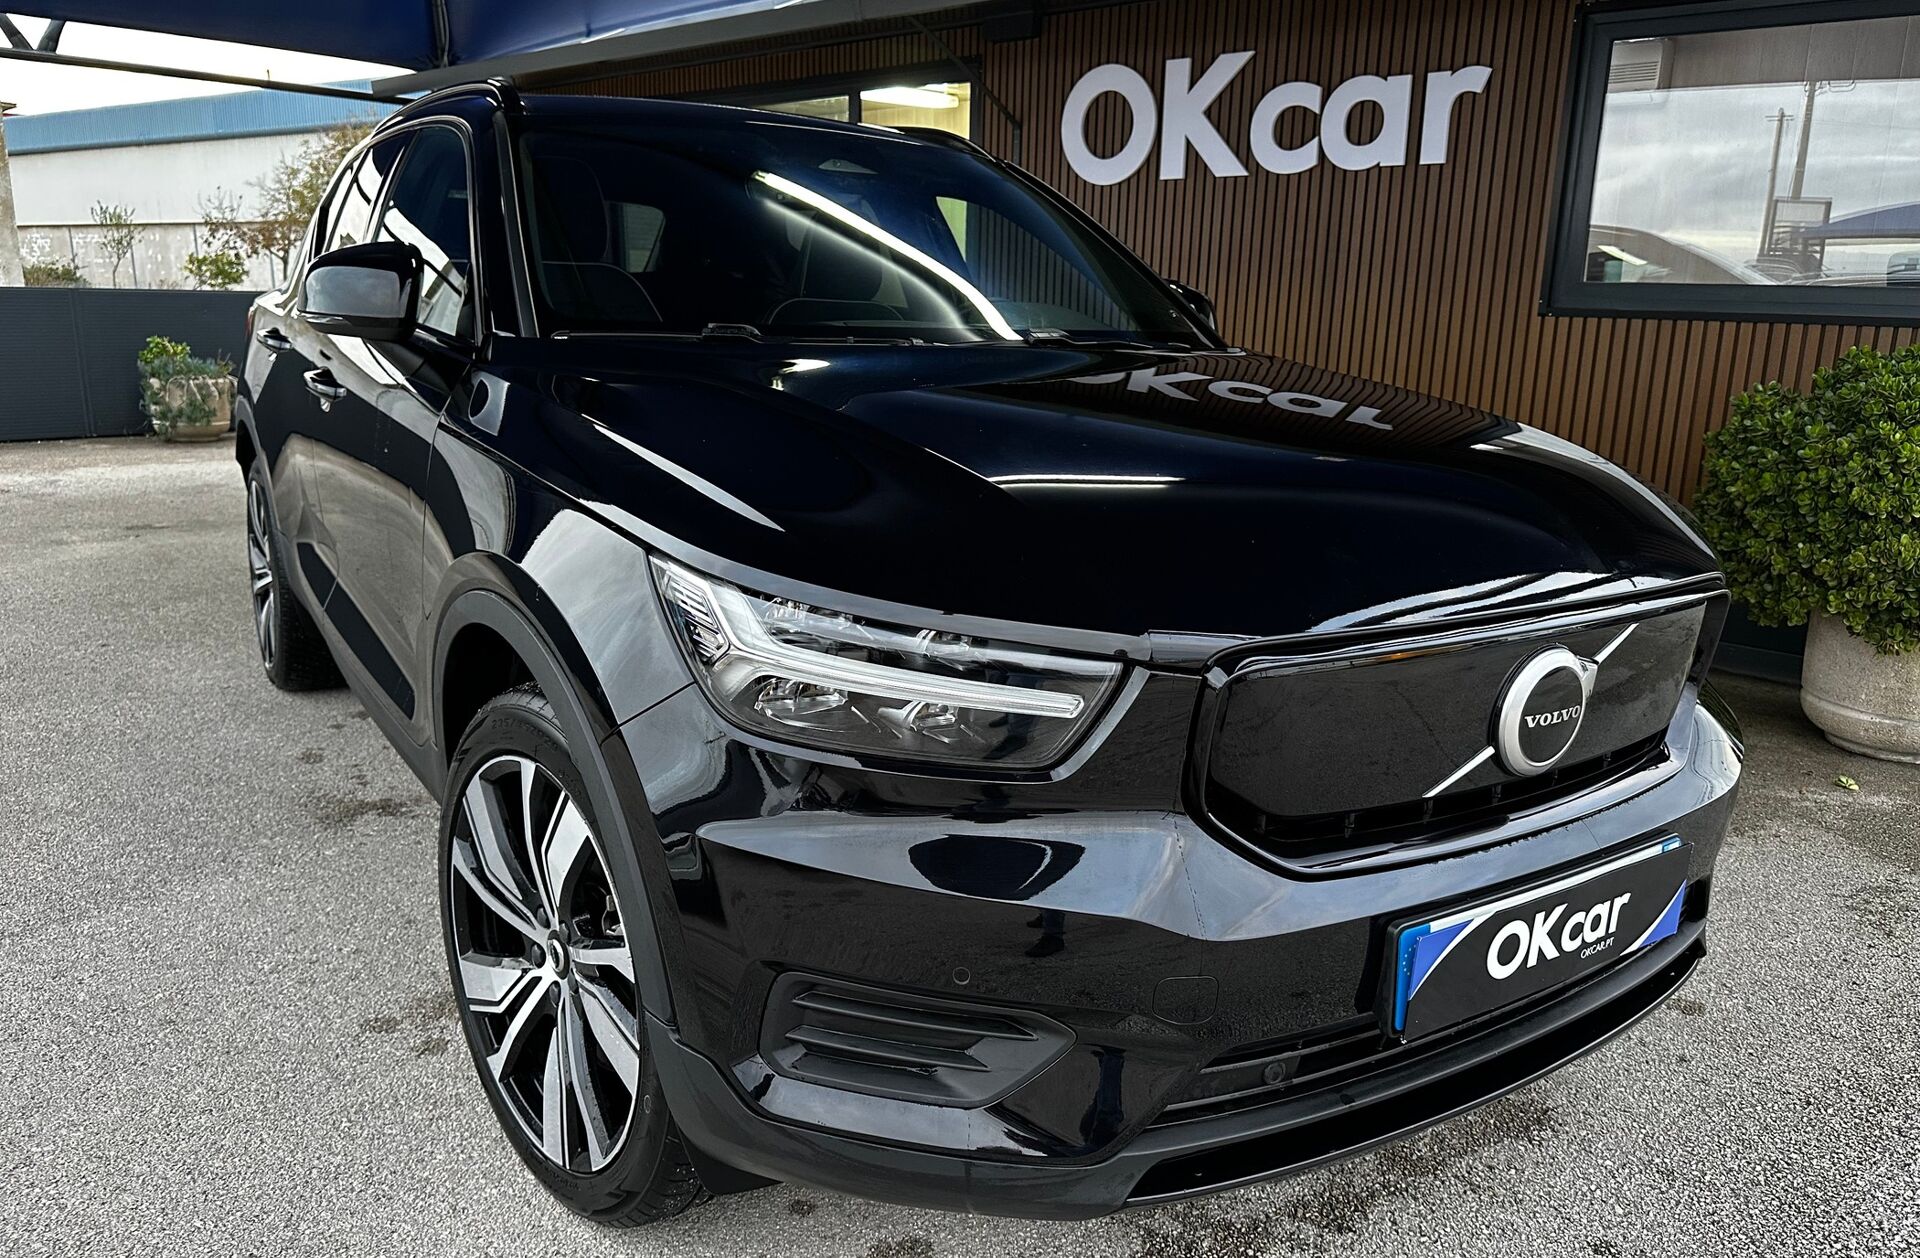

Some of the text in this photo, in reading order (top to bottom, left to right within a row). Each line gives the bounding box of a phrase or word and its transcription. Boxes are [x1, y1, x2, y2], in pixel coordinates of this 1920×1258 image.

[1060, 50, 1493, 186] OKcar
[1524, 705, 1580, 728] VOLVO
[1486, 892, 1632, 980] OKcar
